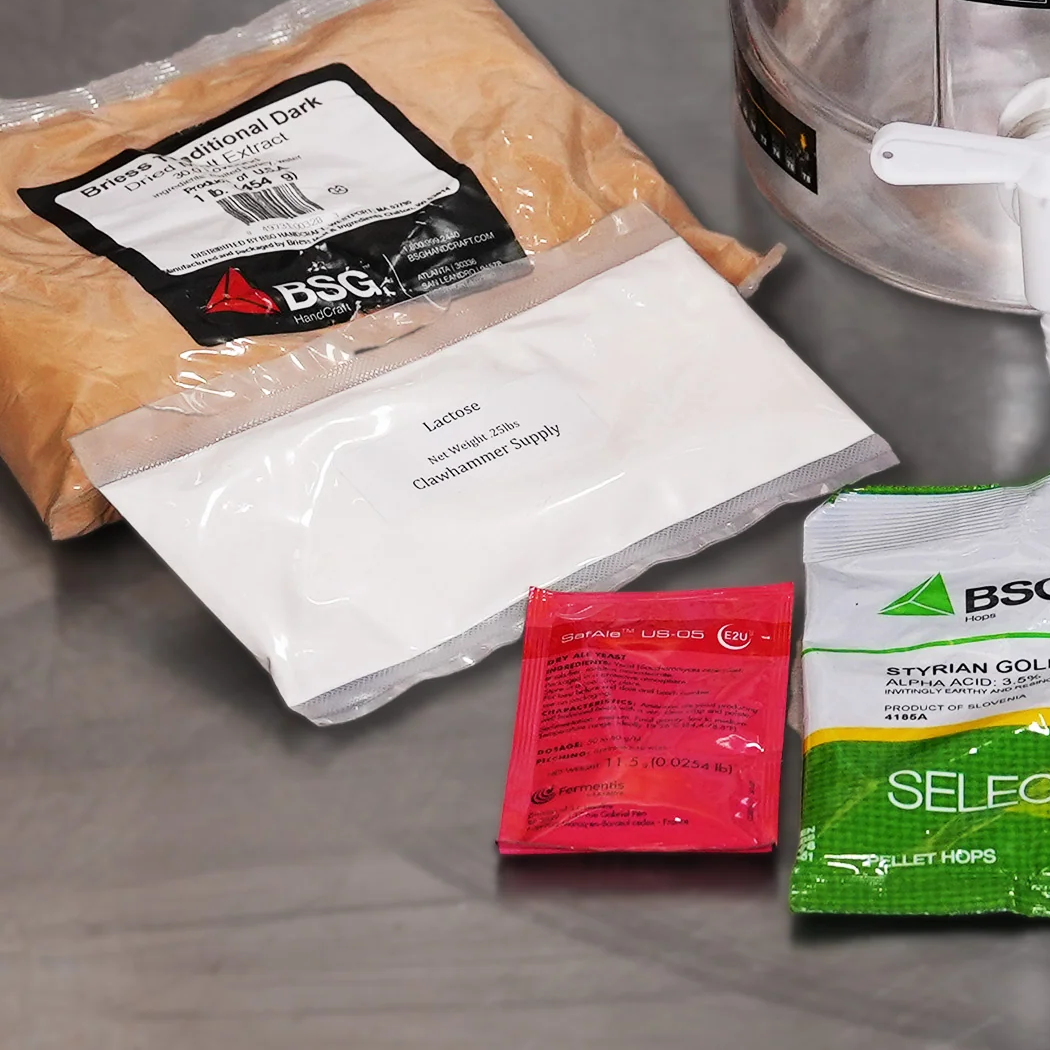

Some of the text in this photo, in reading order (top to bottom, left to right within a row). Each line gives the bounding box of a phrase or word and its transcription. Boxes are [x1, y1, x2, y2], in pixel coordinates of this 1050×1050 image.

[80, 160, 152, 198] Briess
[269, 96, 323, 126] Dark
[124, 162, 177, 192] Dried
[222, 132, 291, 164] Extract
[406, 231, 496, 262] BSGHANDCRAFT.COM
[417, 265, 452, 281] ATLANTA
[273, 270, 384, 312] BSG
[422, 402, 482, 433] Lactose
[412, 423, 562, 490] Clawhammer Supply
[427, 450, 451, 465] Net
[448, 433, 489, 456] Weight
[965, 612, 997, 623] Hops
[641, 629, 705, 640] US-05
[724, 629, 748, 642] E2U
[547, 654, 569, 667] DRY
[595, 651, 627, 661] YEAST
[885, 661, 989, 677] STYRIAN
[885, 672, 1043, 688] ALPHA ACID: 3.5%
[990, 685, 1013, 694] AND
[884, 704, 944, 712] PRODUCT
[947, 703, 964, 712] OF
[967, 693, 1027, 710] SLOVENIA
[558, 780, 625, 796] Fermentis
[941, 848, 997, 866] HOPS
